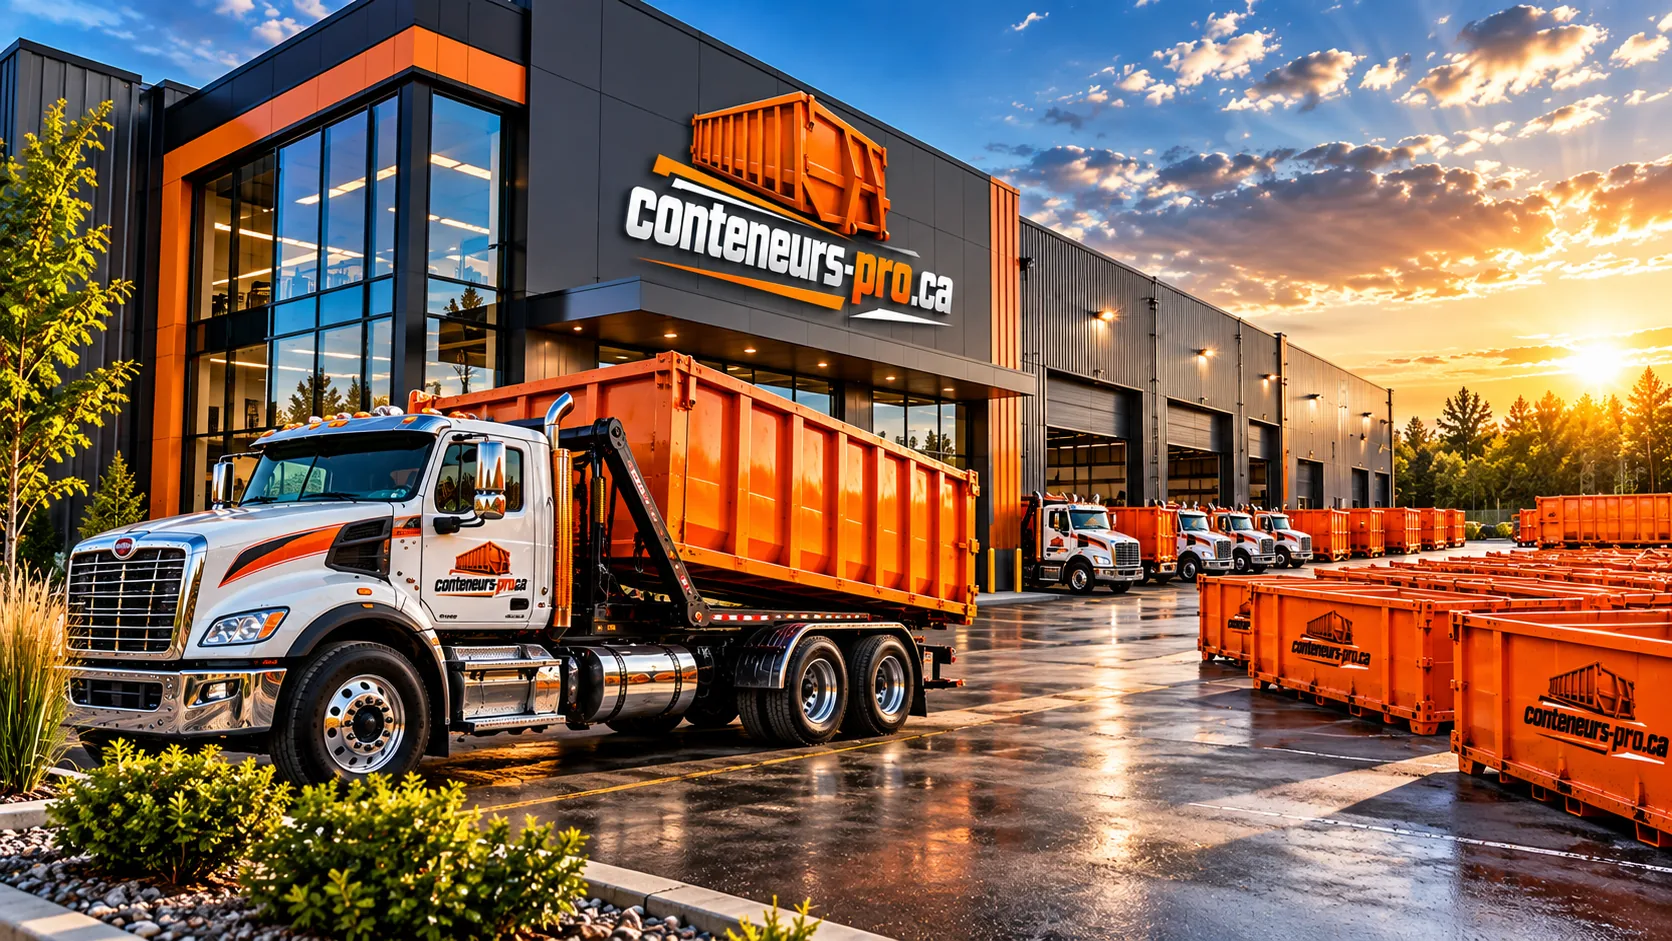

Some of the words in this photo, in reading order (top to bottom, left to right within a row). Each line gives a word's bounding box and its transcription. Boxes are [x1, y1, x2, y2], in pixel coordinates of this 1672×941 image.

[626, 185, 954, 314] conteneurs-pro.ca
[1291, 640, 1371, 666] conteneurs-pro.ca
[1523, 705, 1670, 758] conteneurs-pro.ca
